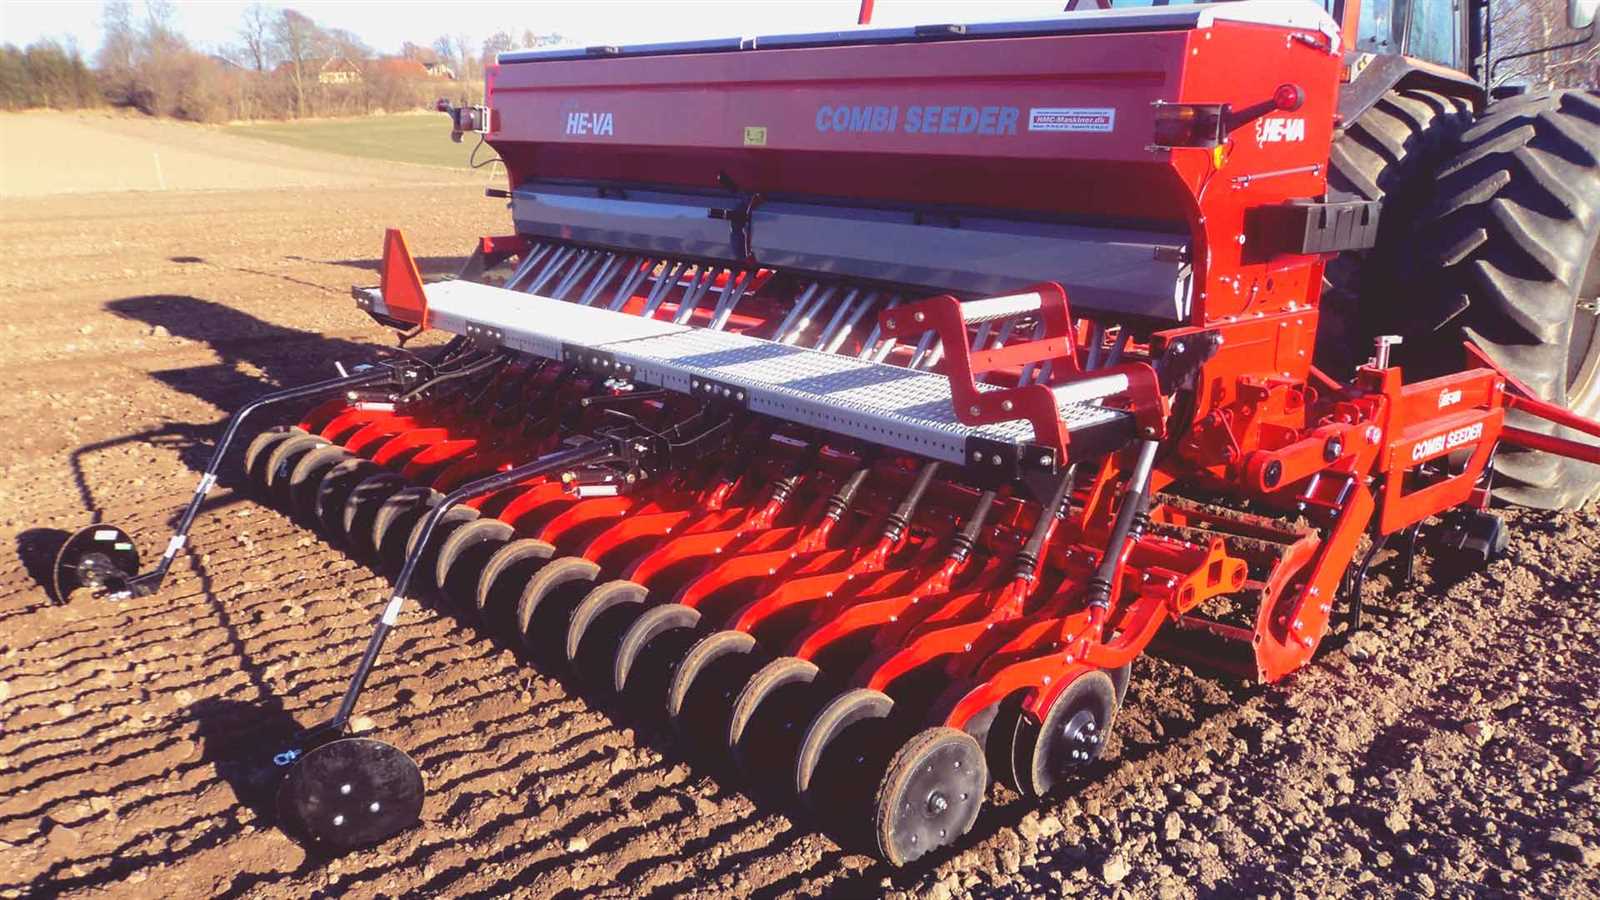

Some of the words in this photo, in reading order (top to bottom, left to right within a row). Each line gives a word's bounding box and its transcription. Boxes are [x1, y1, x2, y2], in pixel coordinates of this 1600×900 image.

[566, 112, 613, 135] HE-VA
[816, 105, 898, 132] COMBI
[905, 106, 1019, 135] SEEDER
[1262, 118, 1304, 142] HE-VA
[1412, 434, 1446, 460] COMBI
[1447, 422, 1483, 448] SEEDER
